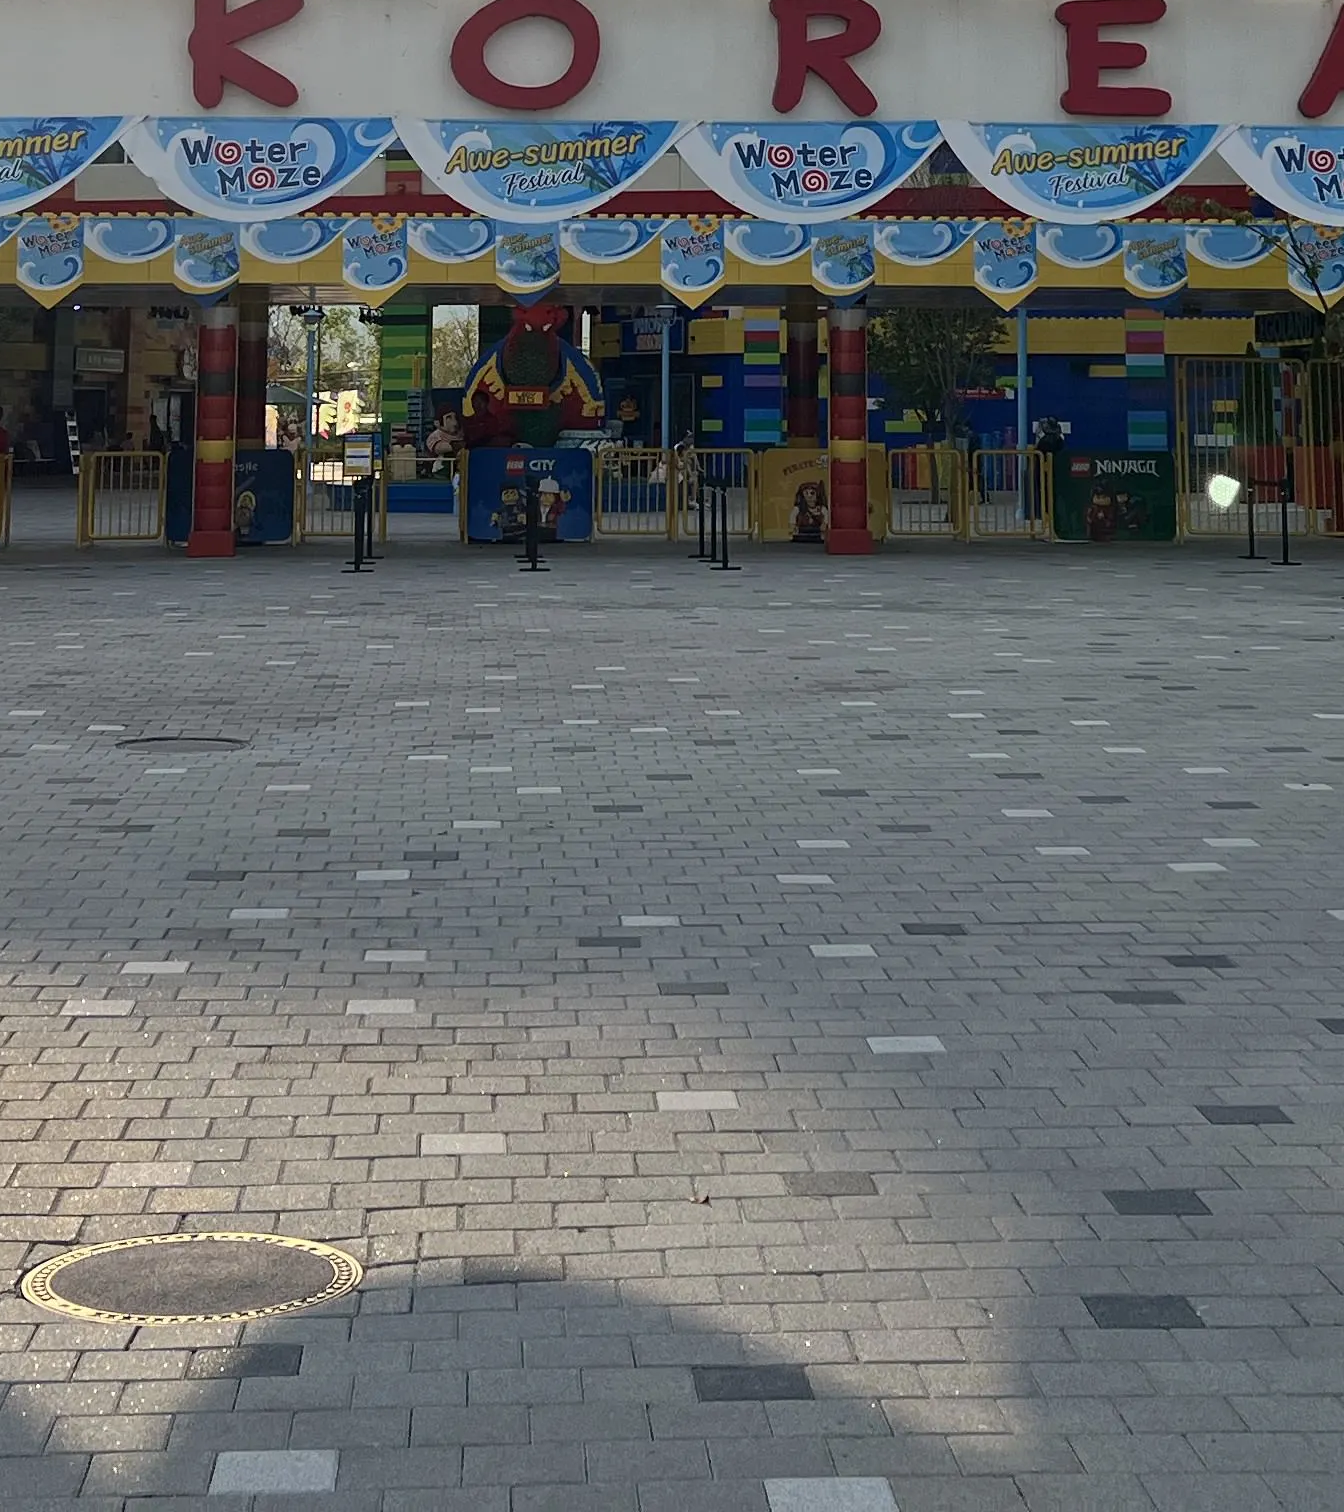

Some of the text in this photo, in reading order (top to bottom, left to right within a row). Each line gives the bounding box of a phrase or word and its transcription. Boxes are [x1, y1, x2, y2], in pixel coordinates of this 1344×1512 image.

[181, 136, 307, 166] Water
[445, 131, 644, 175] Awe-summer
[735, 138, 857, 168] Water
[992, 133, 1186, 177] Awe-summer
[218, 163, 321, 196] Maze
[504, 163, 584, 195] Festival
[773, 165, 873, 198] Maze
[1048, 165, 1127, 198] Festival
[529, 459, 556, 471] CITY
[1094, 458, 1161, 477] NINJAGO
